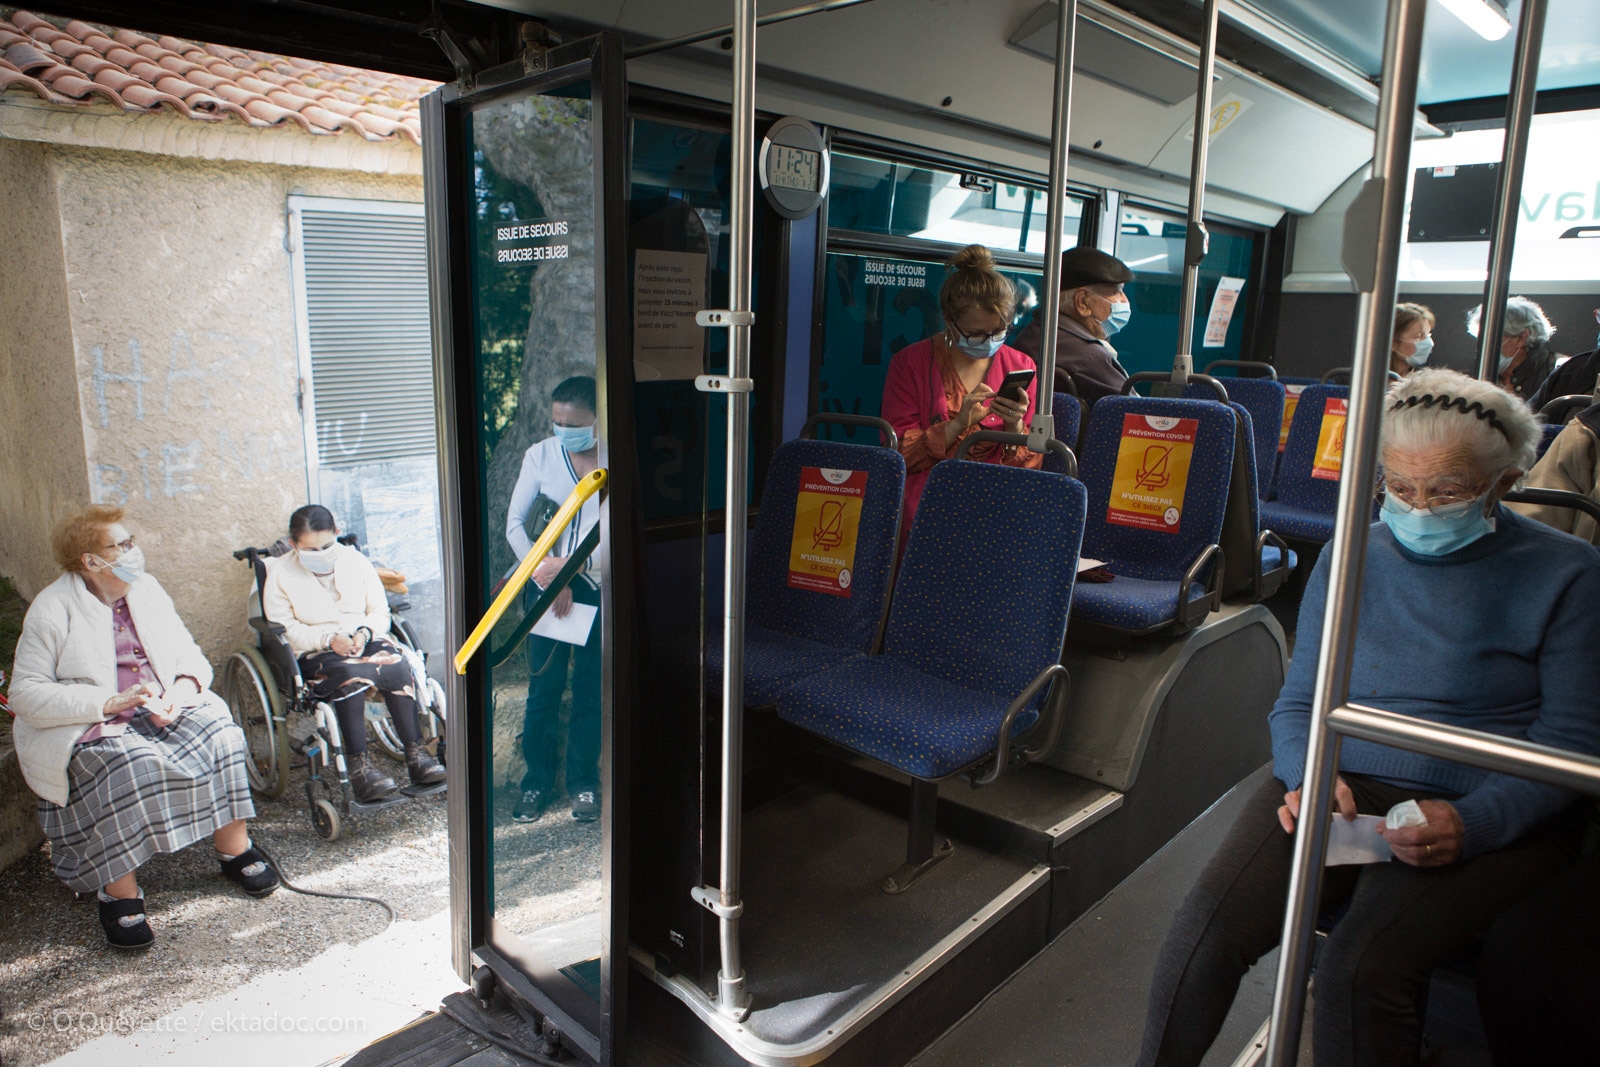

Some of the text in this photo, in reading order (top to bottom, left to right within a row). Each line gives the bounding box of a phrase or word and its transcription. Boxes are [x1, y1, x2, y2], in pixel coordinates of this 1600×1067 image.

[776, 147, 813, 175] 11:24
[497, 221, 568, 240] ISSUE DE SECOURS
[865, 261, 926, 276] ISSUE DE SECOURS
[652, 309, 659, 317] de
[1128, 428, 1191, 440] PRÉVENTION COVID-19
[804, 483, 861, 494] PRÉVENTION COVID-19
[1121, 492, 1158, 504] N'UTILISEZ
[801, 553, 846, 567] N'UTILISEZ PAS
[810, 563, 819, 571] CE
